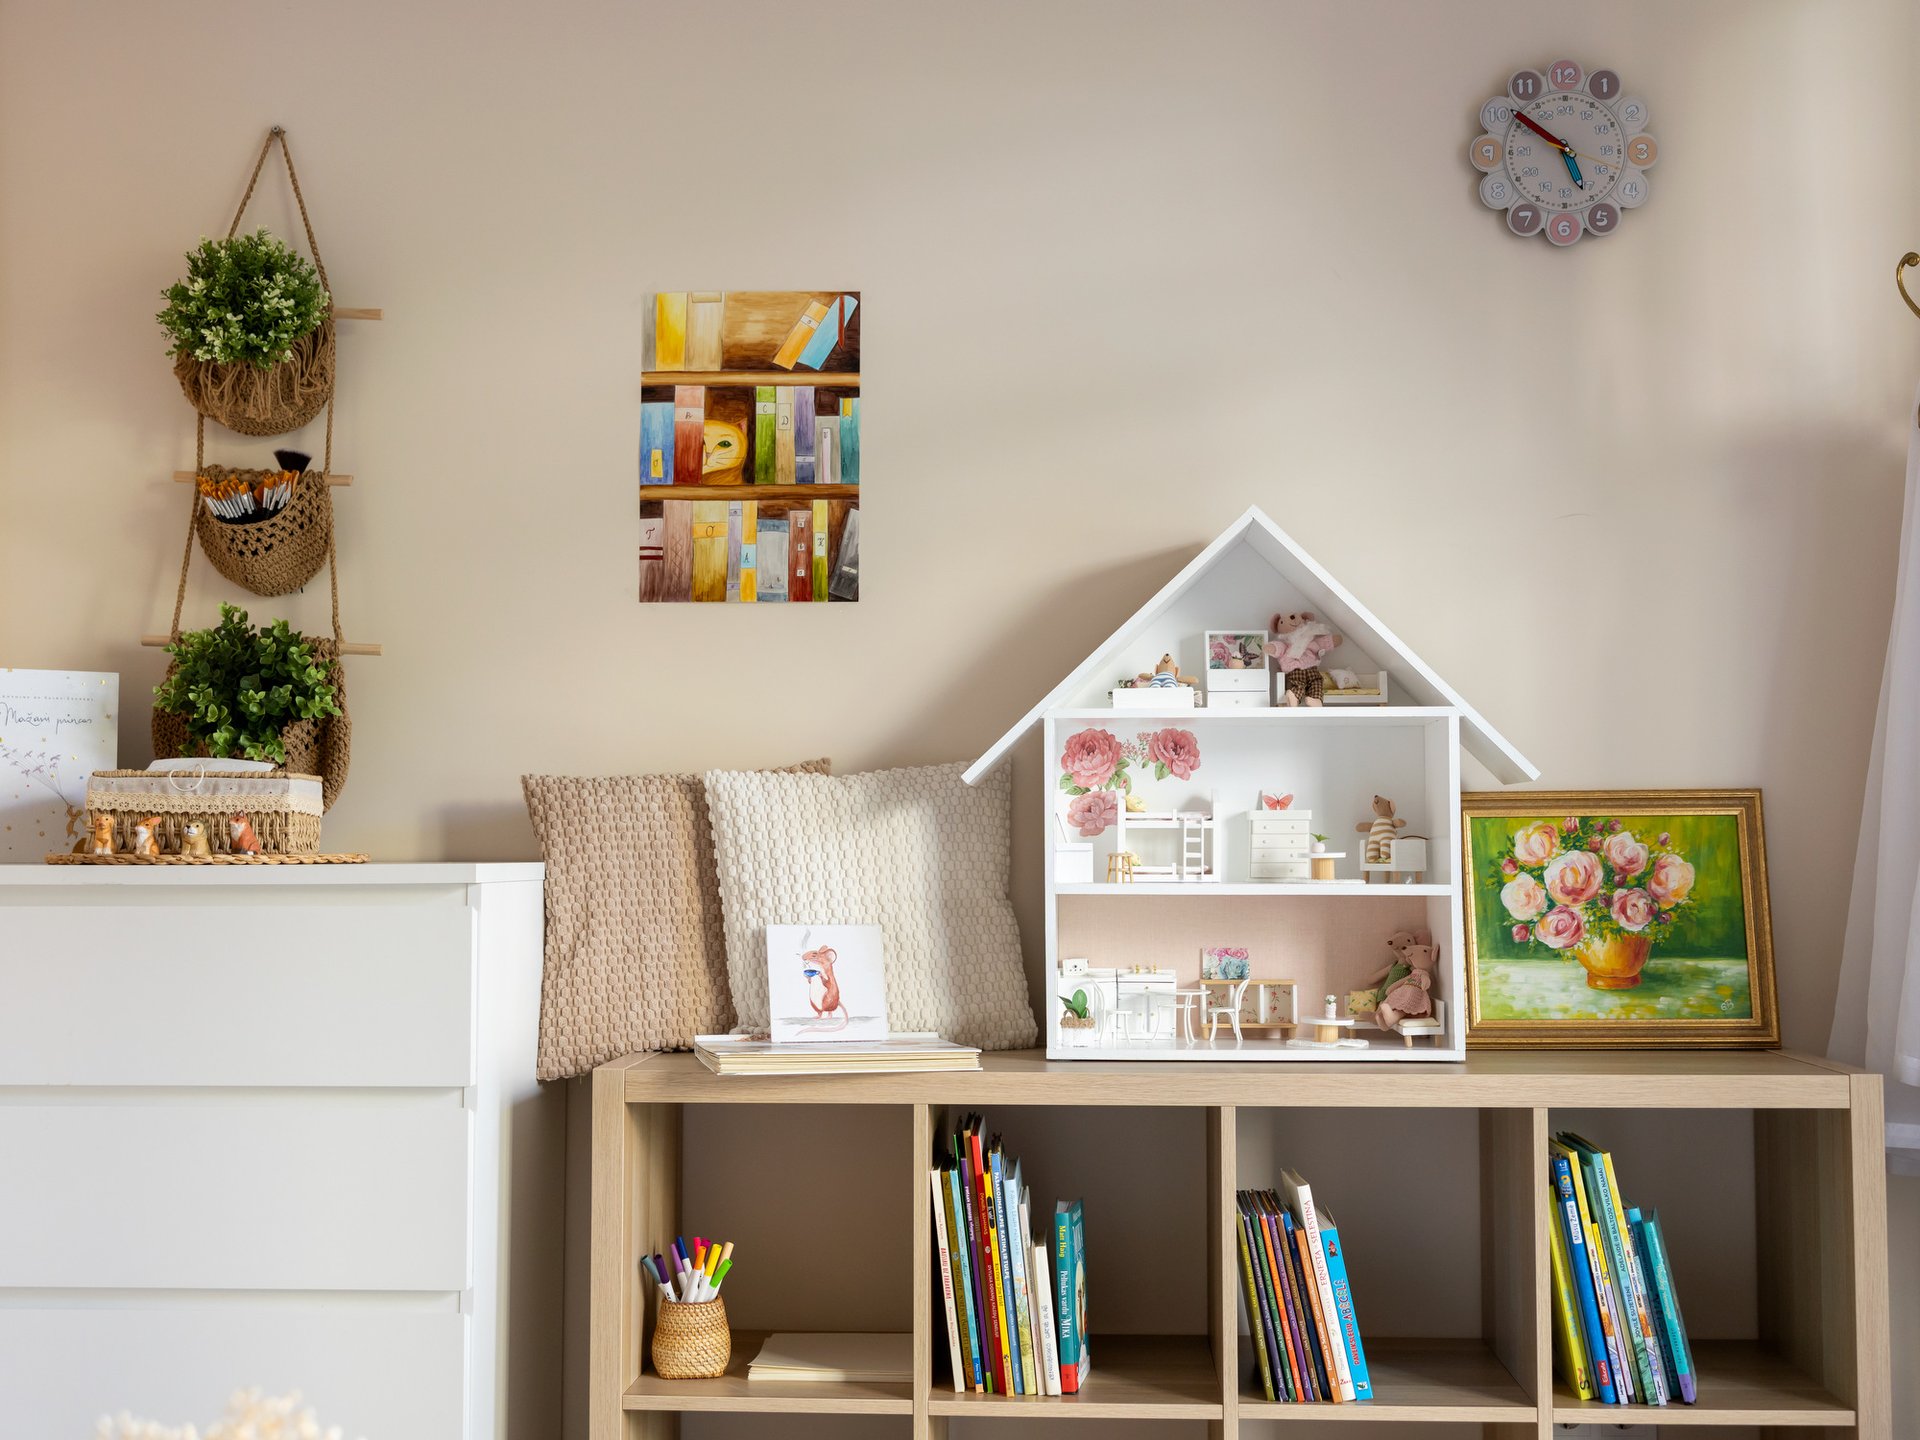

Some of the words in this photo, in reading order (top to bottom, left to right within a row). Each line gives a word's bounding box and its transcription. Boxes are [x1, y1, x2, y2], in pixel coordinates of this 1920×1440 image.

[1555, 68, 1577, 83] 12
[1516, 79, 1533, 94] 11
[1600, 78, 1608, 93] 1
[1488, 107, 1509, 122] 10
[1626, 105, 1640, 120] 2
[1482, 146, 1494, 160] 9
[1635, 144, 1649, 160] 3
[1595, 165, 1608, 175] 16
[1491, 183, 1505, 199] 8
[1539, 182, 1552, 192] 19
[1623, 183, 1639, 198] 4
[1518, 211, 1532, 226] 7
[1595, 210, 1608, 226] 5
[1557, 221, 1570, 236] 6
[55, 714, 92, 735] princas
[1597, 1167, 1606, 1187] NAMAI
[993, 1171, 1003, 1213] PASAKOJIMAS
[1602, 1188, 1610, 1206] VILKO
[1606, 1206, 1617, 1234] BALTOJO
[1058, 1225, 1066, 1240] Matt
[1058, 1241, 1067, 1257] Haig
[1059, 1270, 1069, 1295] Peliukas
[1060, 1296, 1069, 1314] vardu
[1060, 1315, 1072, 1338] MIKA
[1631, 1317, 1640, 1338] JOVILĖ
